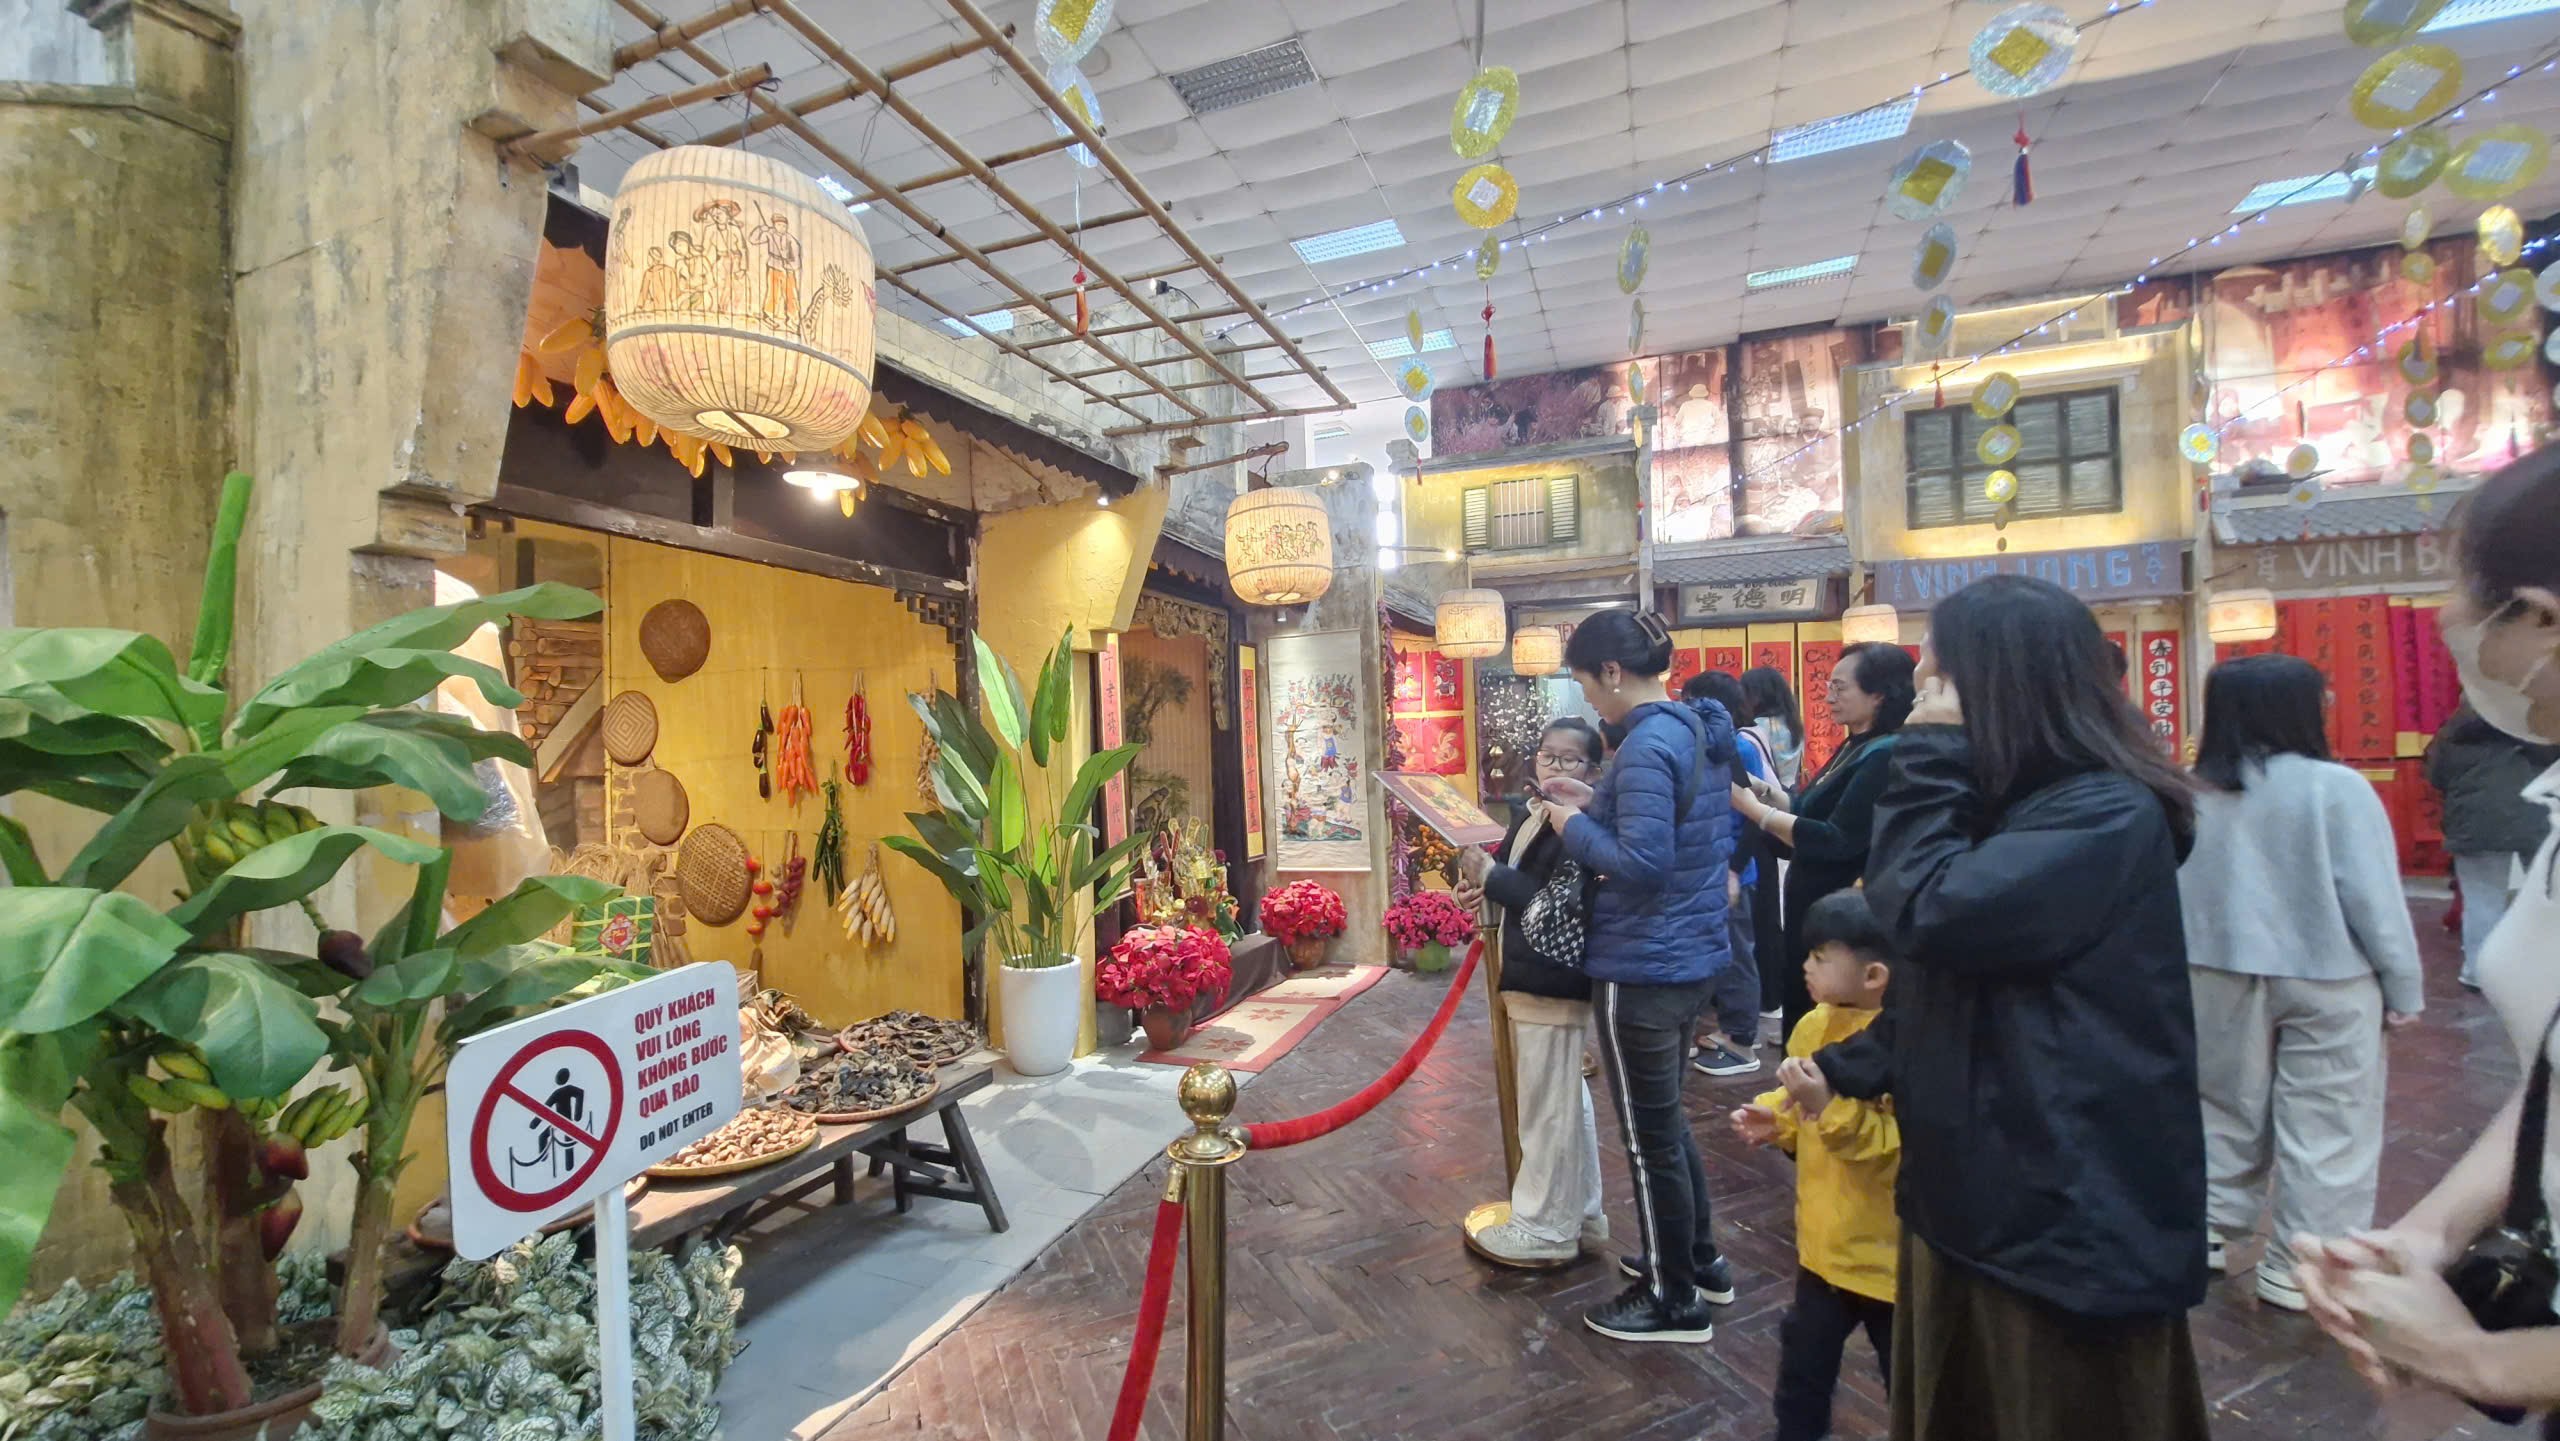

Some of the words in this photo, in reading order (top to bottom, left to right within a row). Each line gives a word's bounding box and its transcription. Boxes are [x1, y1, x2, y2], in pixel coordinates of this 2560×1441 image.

[2293, 536, 2404, 579] VINH
[635, 1003, 663, 1034] QUÝ
[668, 988, 715, 1021] KHÁCH
[636, 1035, 661, 1061] VUI
[666, 1019, 701, 1049] LÒNG
[638, 1052, 687, 1090] KHÔNG
[691, 1034, 728, 1066] BƯỚC
[640, 1088, 668, 1118] QUA
[672, 1073, 700, 1102] RÀO
[640, 1131, 655, 1151] DO
[659, 1118, 680, 1141] NOT
[682, 1101, 713, 1129] ENTER
